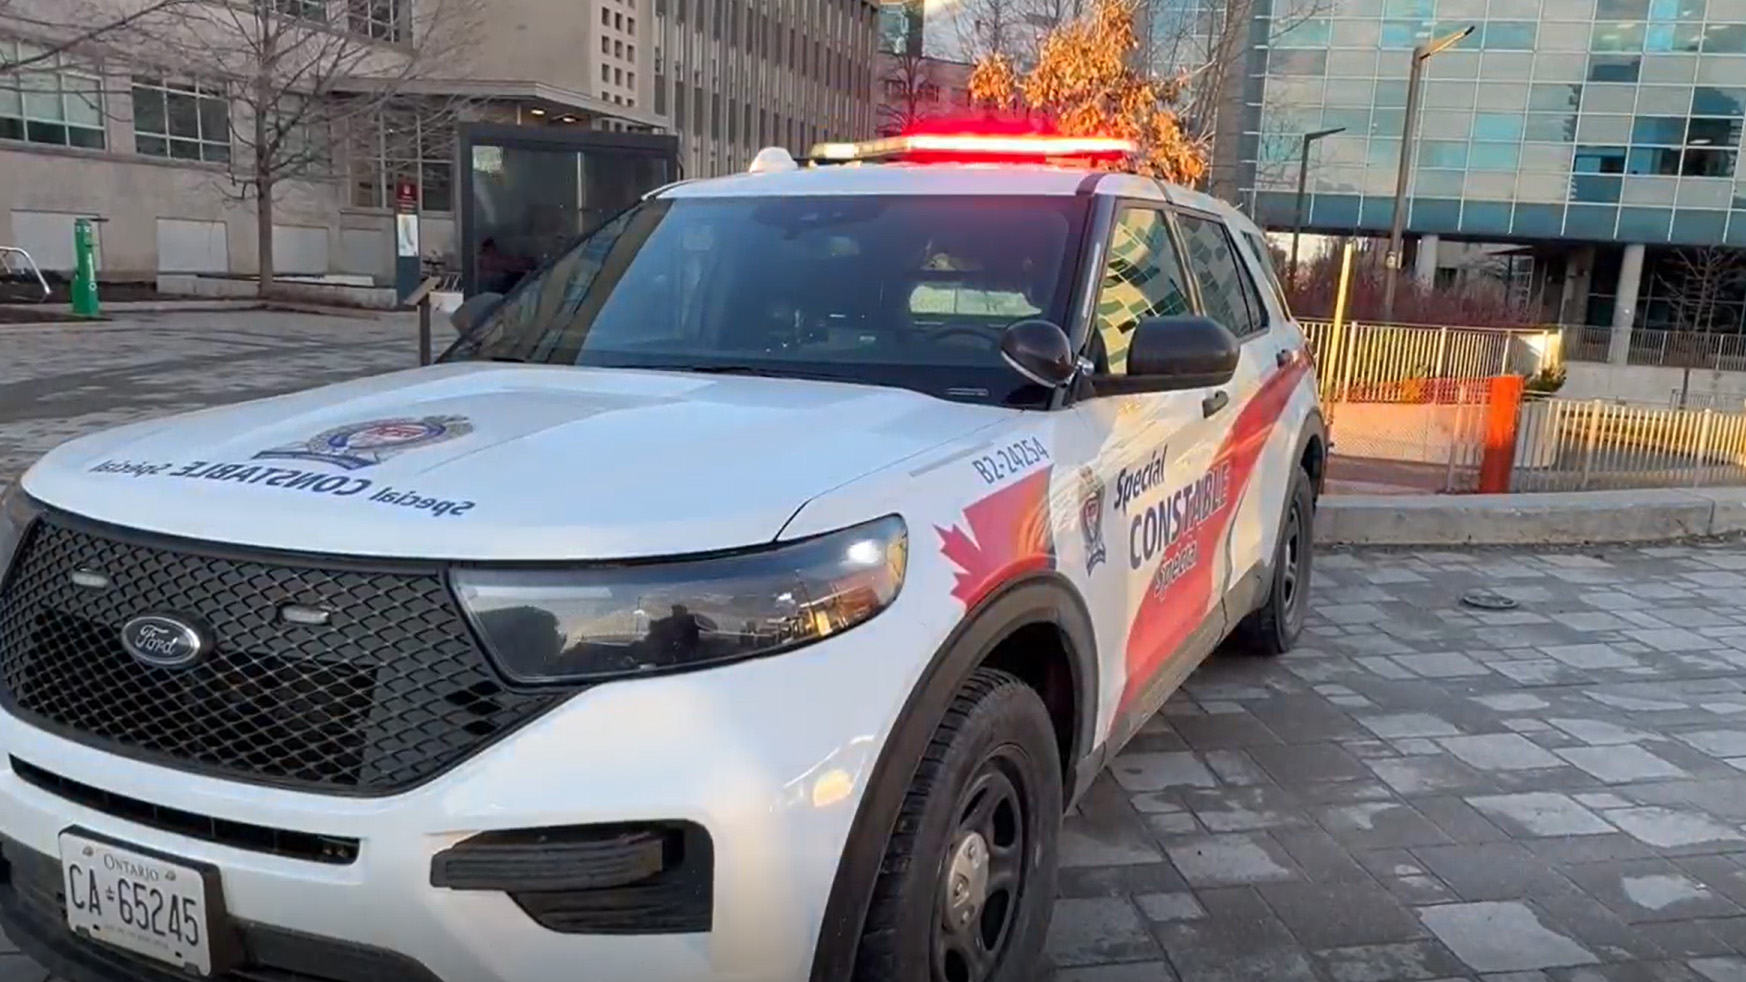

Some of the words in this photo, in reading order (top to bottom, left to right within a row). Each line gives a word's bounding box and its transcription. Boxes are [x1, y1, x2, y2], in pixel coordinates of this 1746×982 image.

[972, 436, 1050, 485] B2-24254
[1113, 443, 1168, 515] Special
[1130, 459, 1230, 570] CONSTABLE
[135, 623, 179, 655] Ford
[103, 853, 160, 882] ONTARIO
